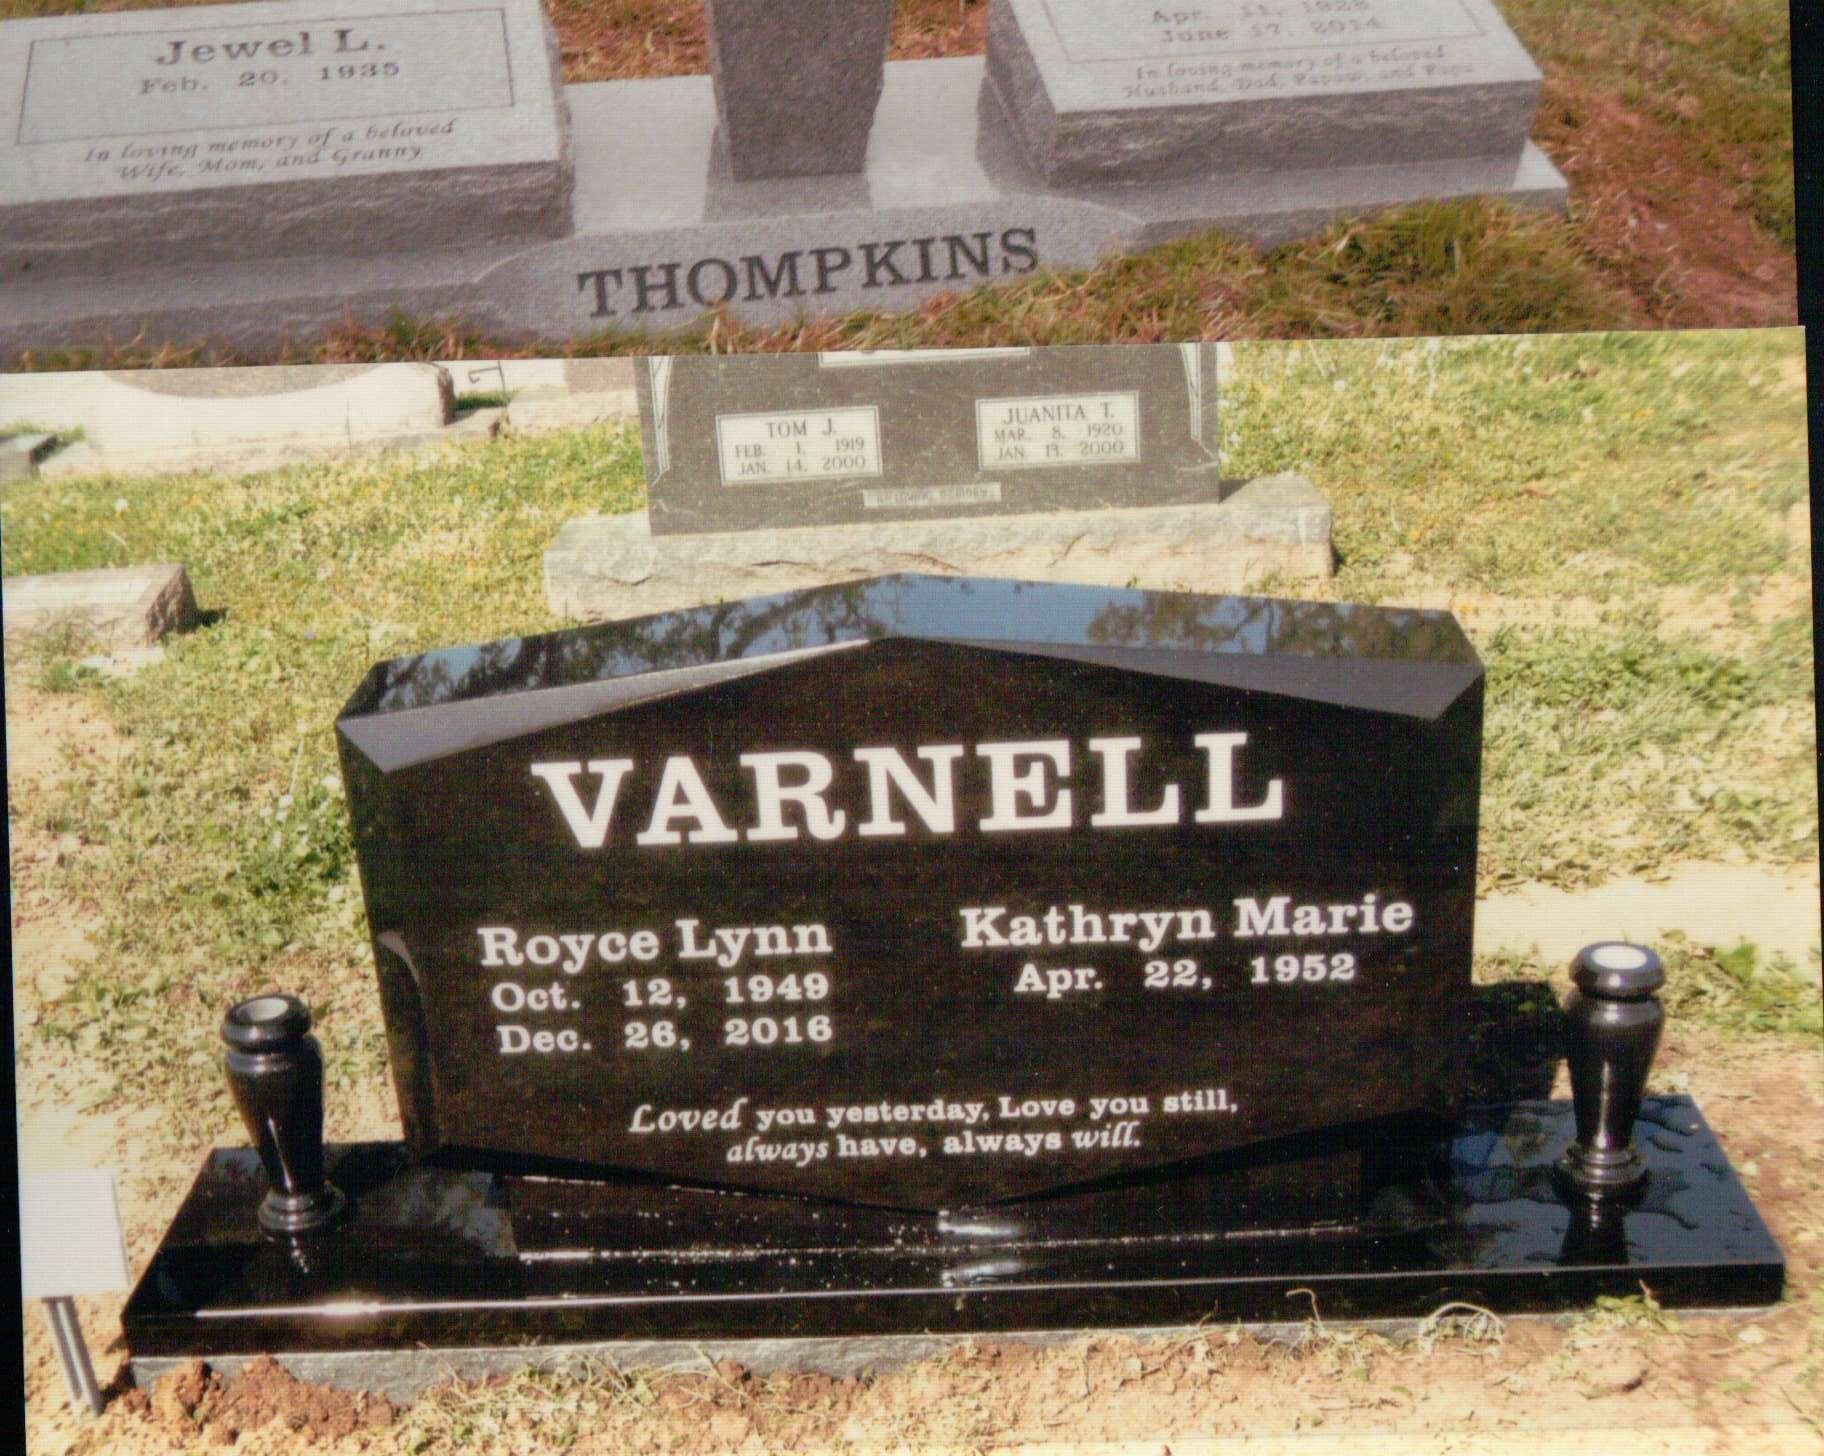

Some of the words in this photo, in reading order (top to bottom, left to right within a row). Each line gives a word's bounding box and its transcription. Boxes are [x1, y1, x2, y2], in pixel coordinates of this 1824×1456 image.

[156, 31, 310, 66] Jewel
[335, 28, 386, 53] L.
[140, 75, 207, 95] Feb.
[320, 61, 400, 81] 1935
[84, 147, 110, 164] In
[121, 143, 198, 162] loving
[208, 135, 298, 154] memory
[307, 127, 334, 147] of
[341, 131, 355, 144] a
[365, 118, 458, 138] beloved
[275, 151, 320, 168] and
[332, 144, 423, 166] Granny
[578, 227, 1039, 318] THOMPKINS
[765, 419, 808, 439] TOM
[1002, 403, 1087, 425] JUANITA
[1100, 401, 1115, 420] T.
[1087, 421, 1124, 438] 1920
[822, 453, 866, 471] 2000
[834, 436, 865, 453] 1919
[1079, 439, 1125, 456] 2000
[530, 731, 1284, 849] VARNELL
[959, 904, 1216, 953] Kathryn
[1233, 893, 1415, 937] Marie
[477, 926, 660, 972] Royce
[675, 918, 834, 963] Lynn
[491, 980, 581, 1013] Oct.
[622, 977, 687, 1008] 12,
[722, 971, 830, 1003] 1949
[1013, 962, 1103, 1000] Apr.
[1143, 960, 1212, 990] 22,
[1250, 952, 1356, 984] 1952
[497, 1024, 592, 1055] Dec.
[624, 1020, 690, 1051] 26,
[724, 1014, 833, 1046] 2016
[628, 1096, 748, 1134] Loved
[755, 1108, 817, 1131] you
[826, 1099, 990, 1129] yesterday,
[998, 1095, 1076, 1120] Love
[1089, 1099, 1151, 1123] you
[1162, 1088, 1239, 1115] still,
[726, 1135, 829, 1166] always
[836, 1133, 927, 1158] have,
[943, 1128, 1063, 1156] always
[1070, 1121, 1141, 1149] will.
